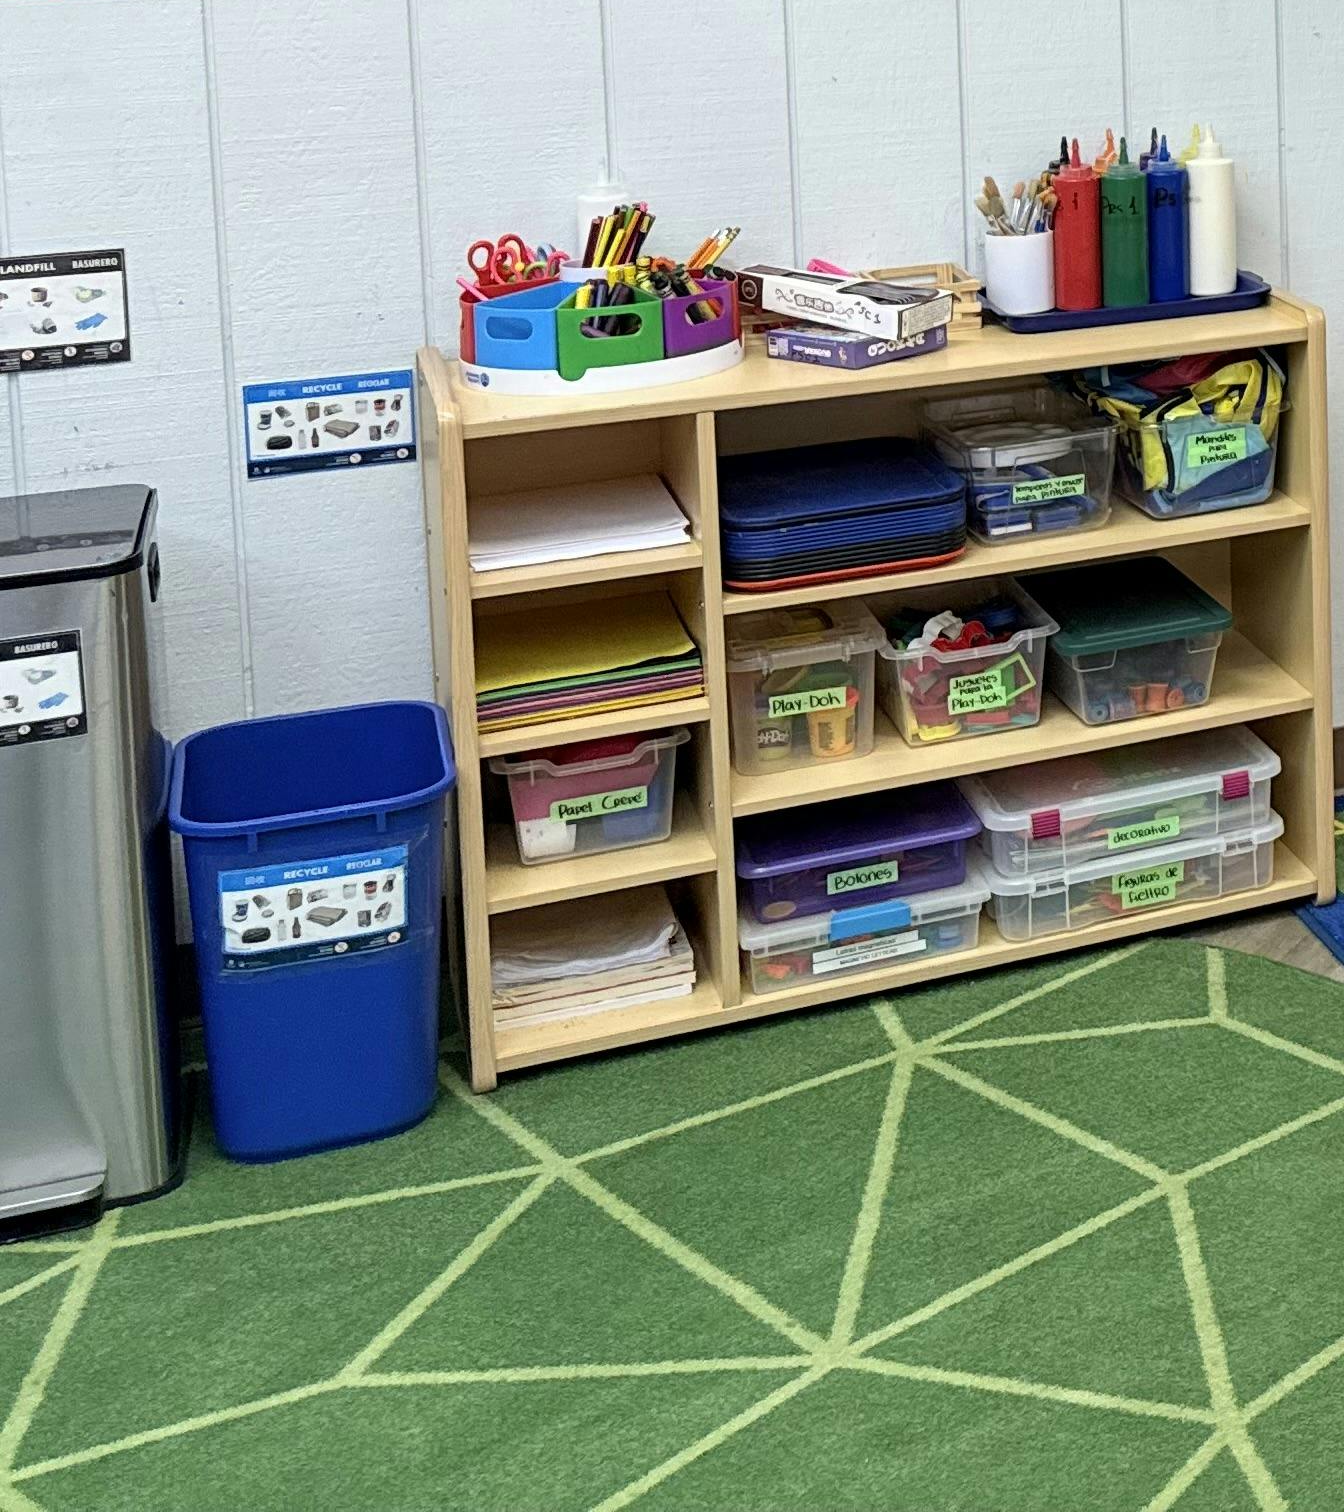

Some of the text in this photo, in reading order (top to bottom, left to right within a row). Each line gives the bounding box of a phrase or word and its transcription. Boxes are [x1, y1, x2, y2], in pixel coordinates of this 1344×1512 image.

[1, 257, 118, 275] LANDFILL BASURERO
[302, 383, 343, 394] RECYCLE
[772, 693, 841, 714] Play-Doh
[951, 693, 1003, 711] Play-Doh
[557, 801, 593, 819] Papel
[283, 865, 329, 880] RECYCLE
[834, 867, 893, 891] Botones
